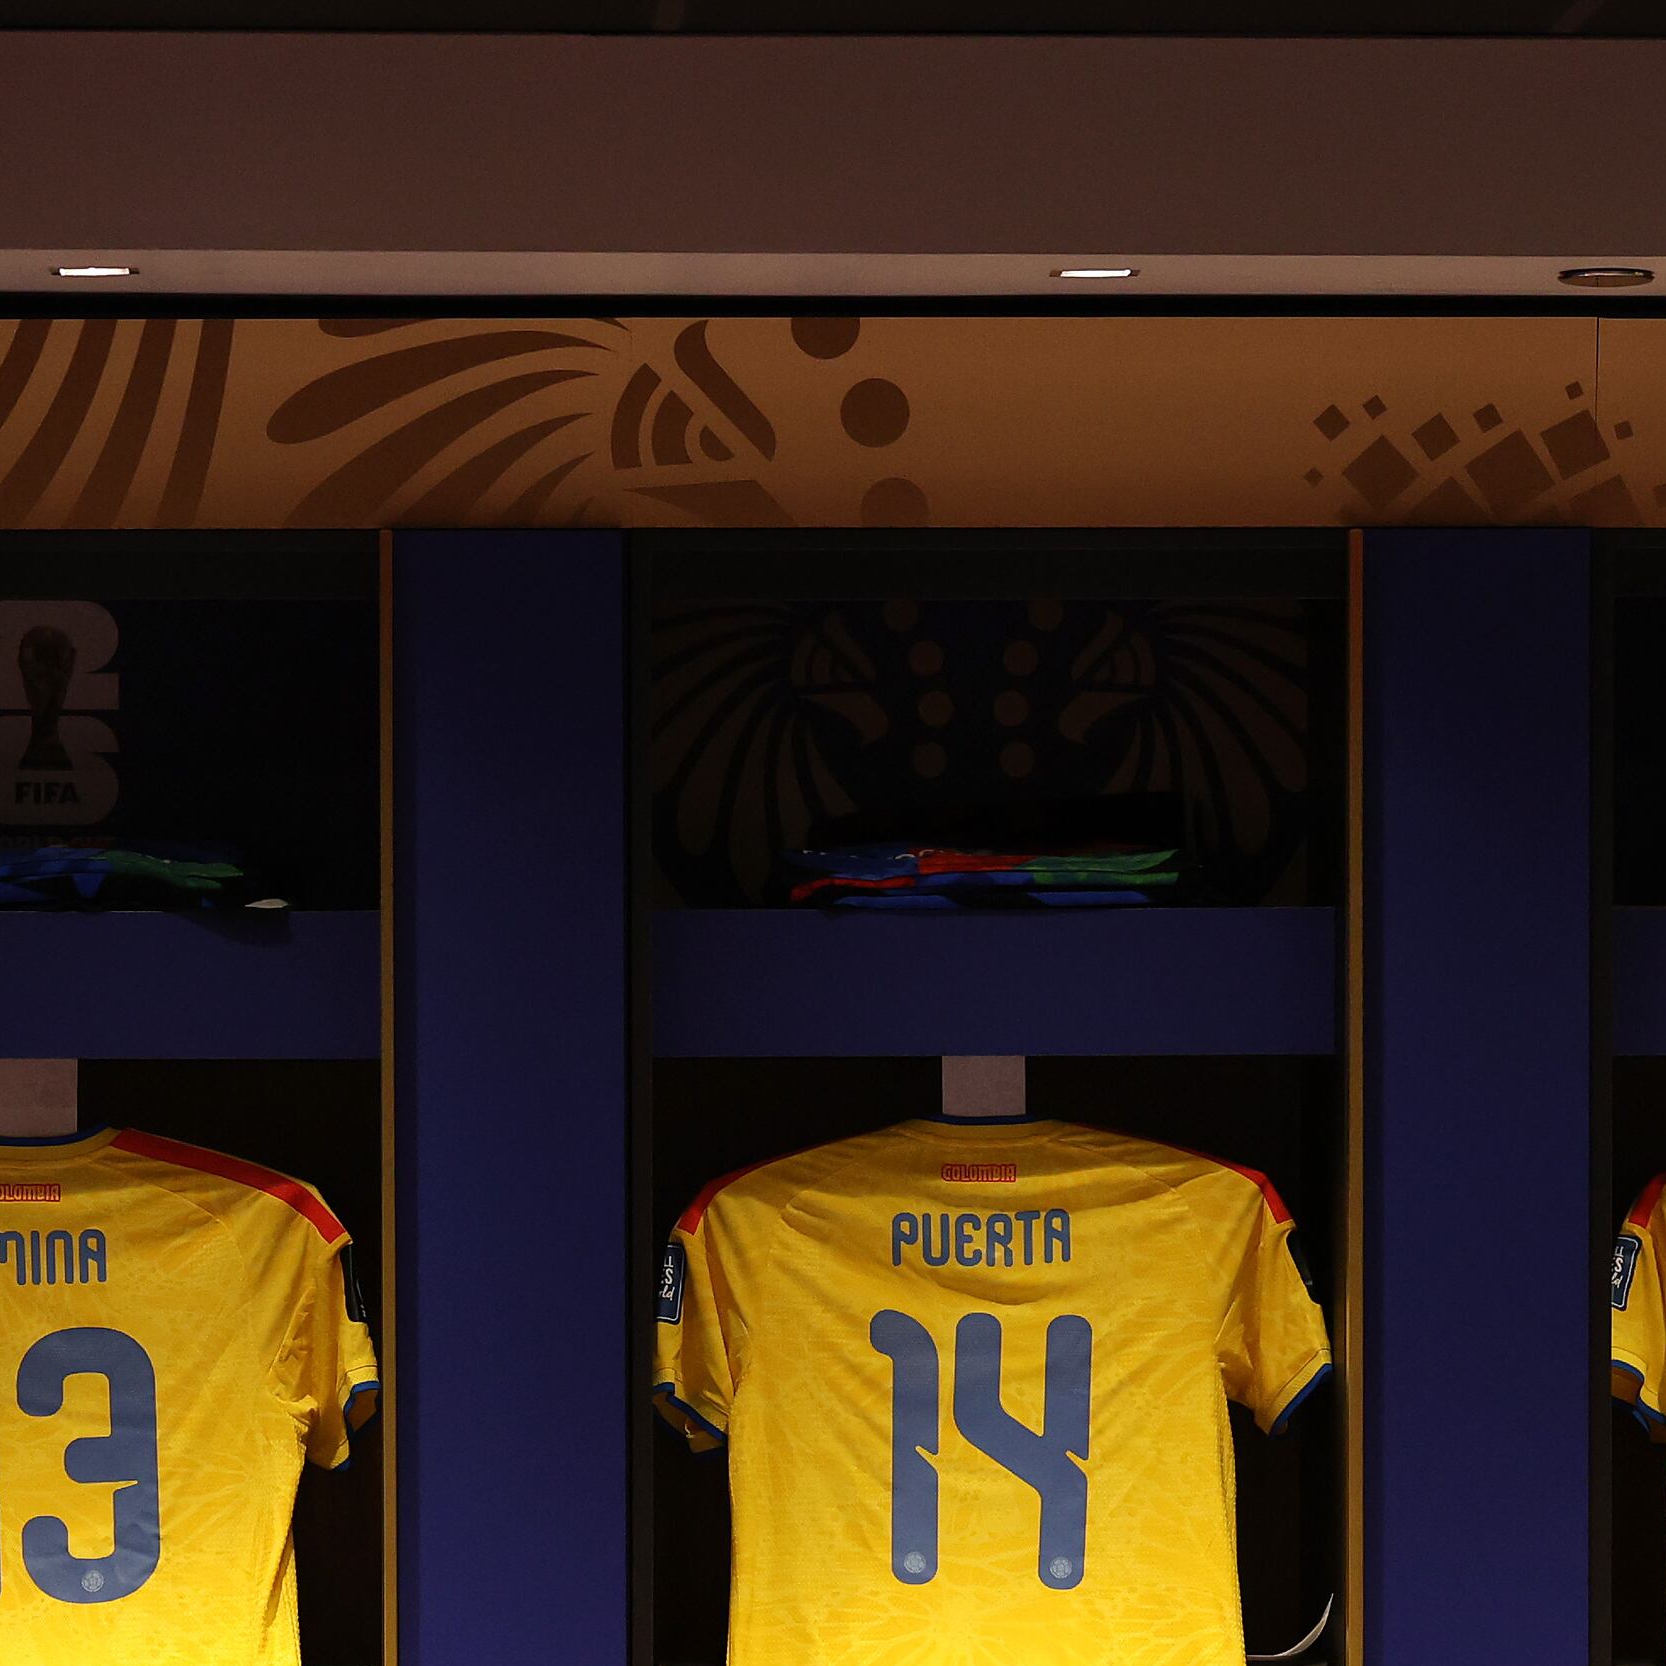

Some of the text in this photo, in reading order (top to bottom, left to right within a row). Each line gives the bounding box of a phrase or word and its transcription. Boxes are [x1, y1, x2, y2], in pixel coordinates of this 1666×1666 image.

[14, 781, 80, 804] FIFA
[891, 1207, 1072, 1268] PUERTA
[870, 1309, 1093, 1591] 14
